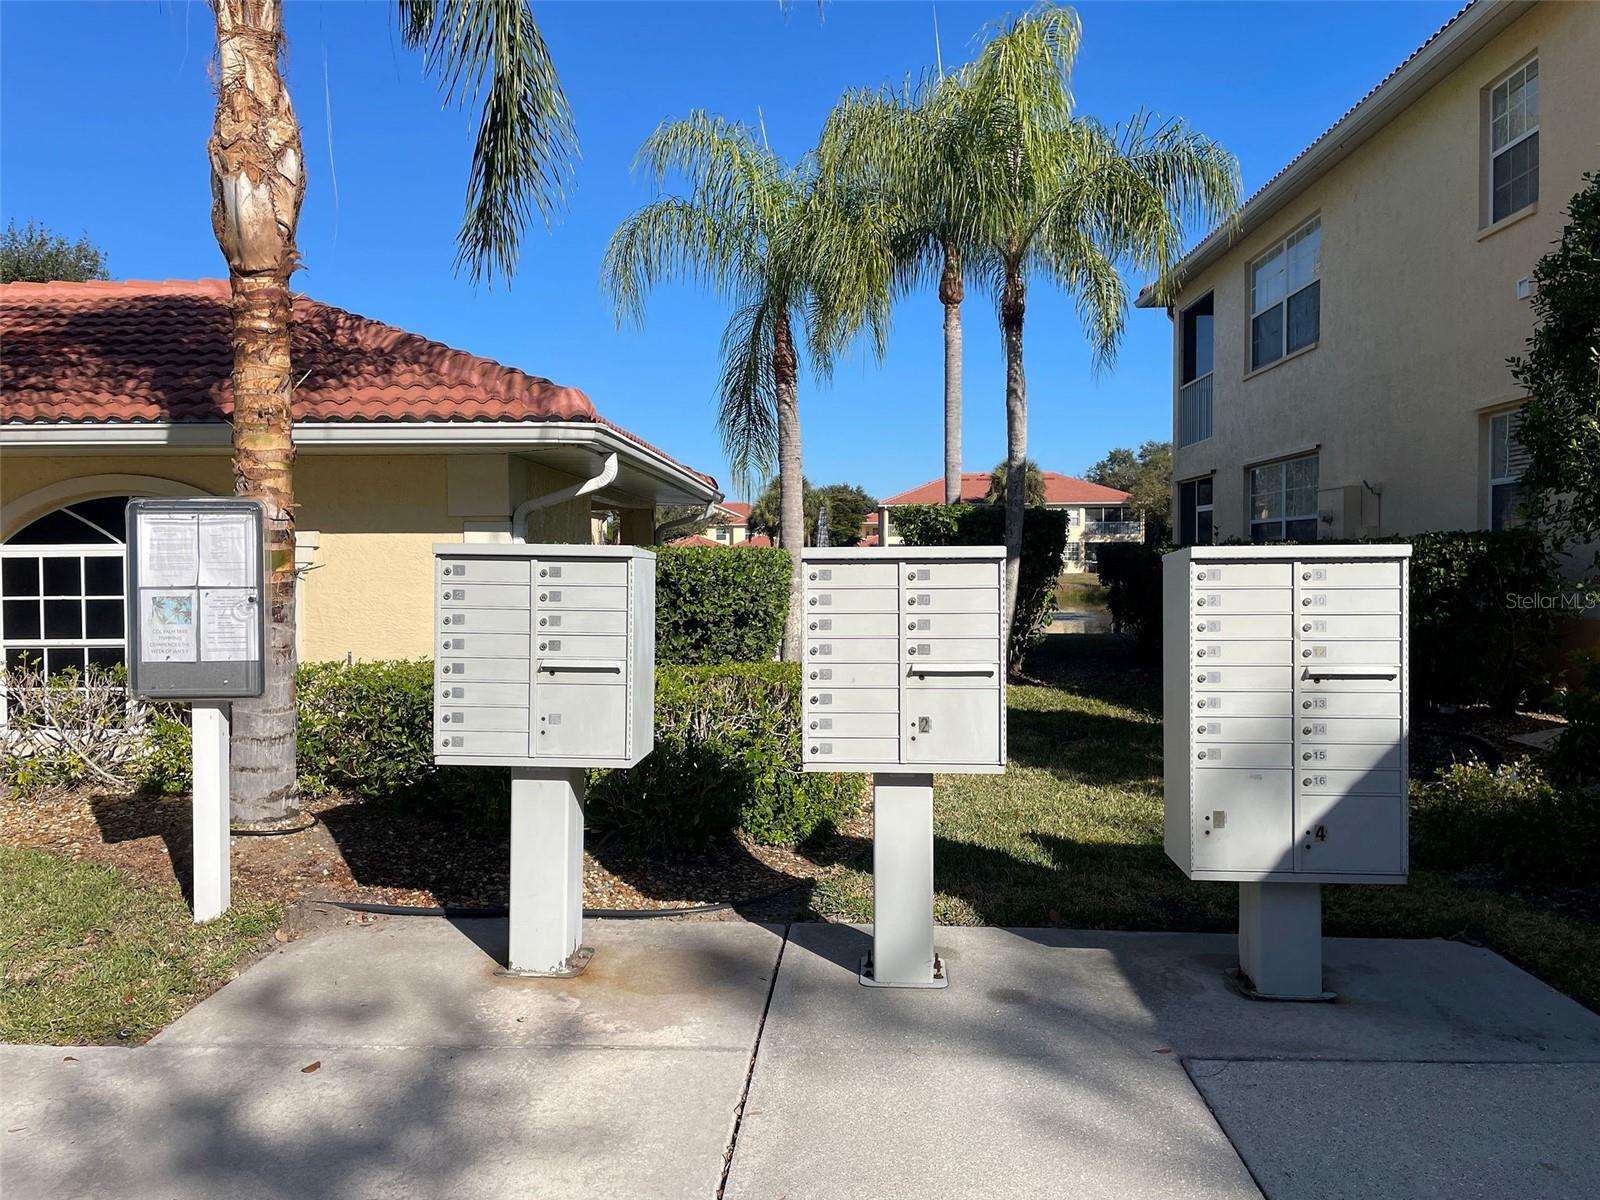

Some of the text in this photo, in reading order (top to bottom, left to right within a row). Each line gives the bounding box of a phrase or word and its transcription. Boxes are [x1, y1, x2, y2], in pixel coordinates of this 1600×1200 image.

[1313, 596, 1325, 605] 10
[1314, 622, 1325, 631] 11
[1313, 700, 1325, 708] 13
[920, 718, 929, 732] 2
[1313, 725, 1325, 734] 14
[1313, 751, 1325, 760] 15
[1313, 775, 1325, 784] 16
[1315, 825, 1327, 841] 4
